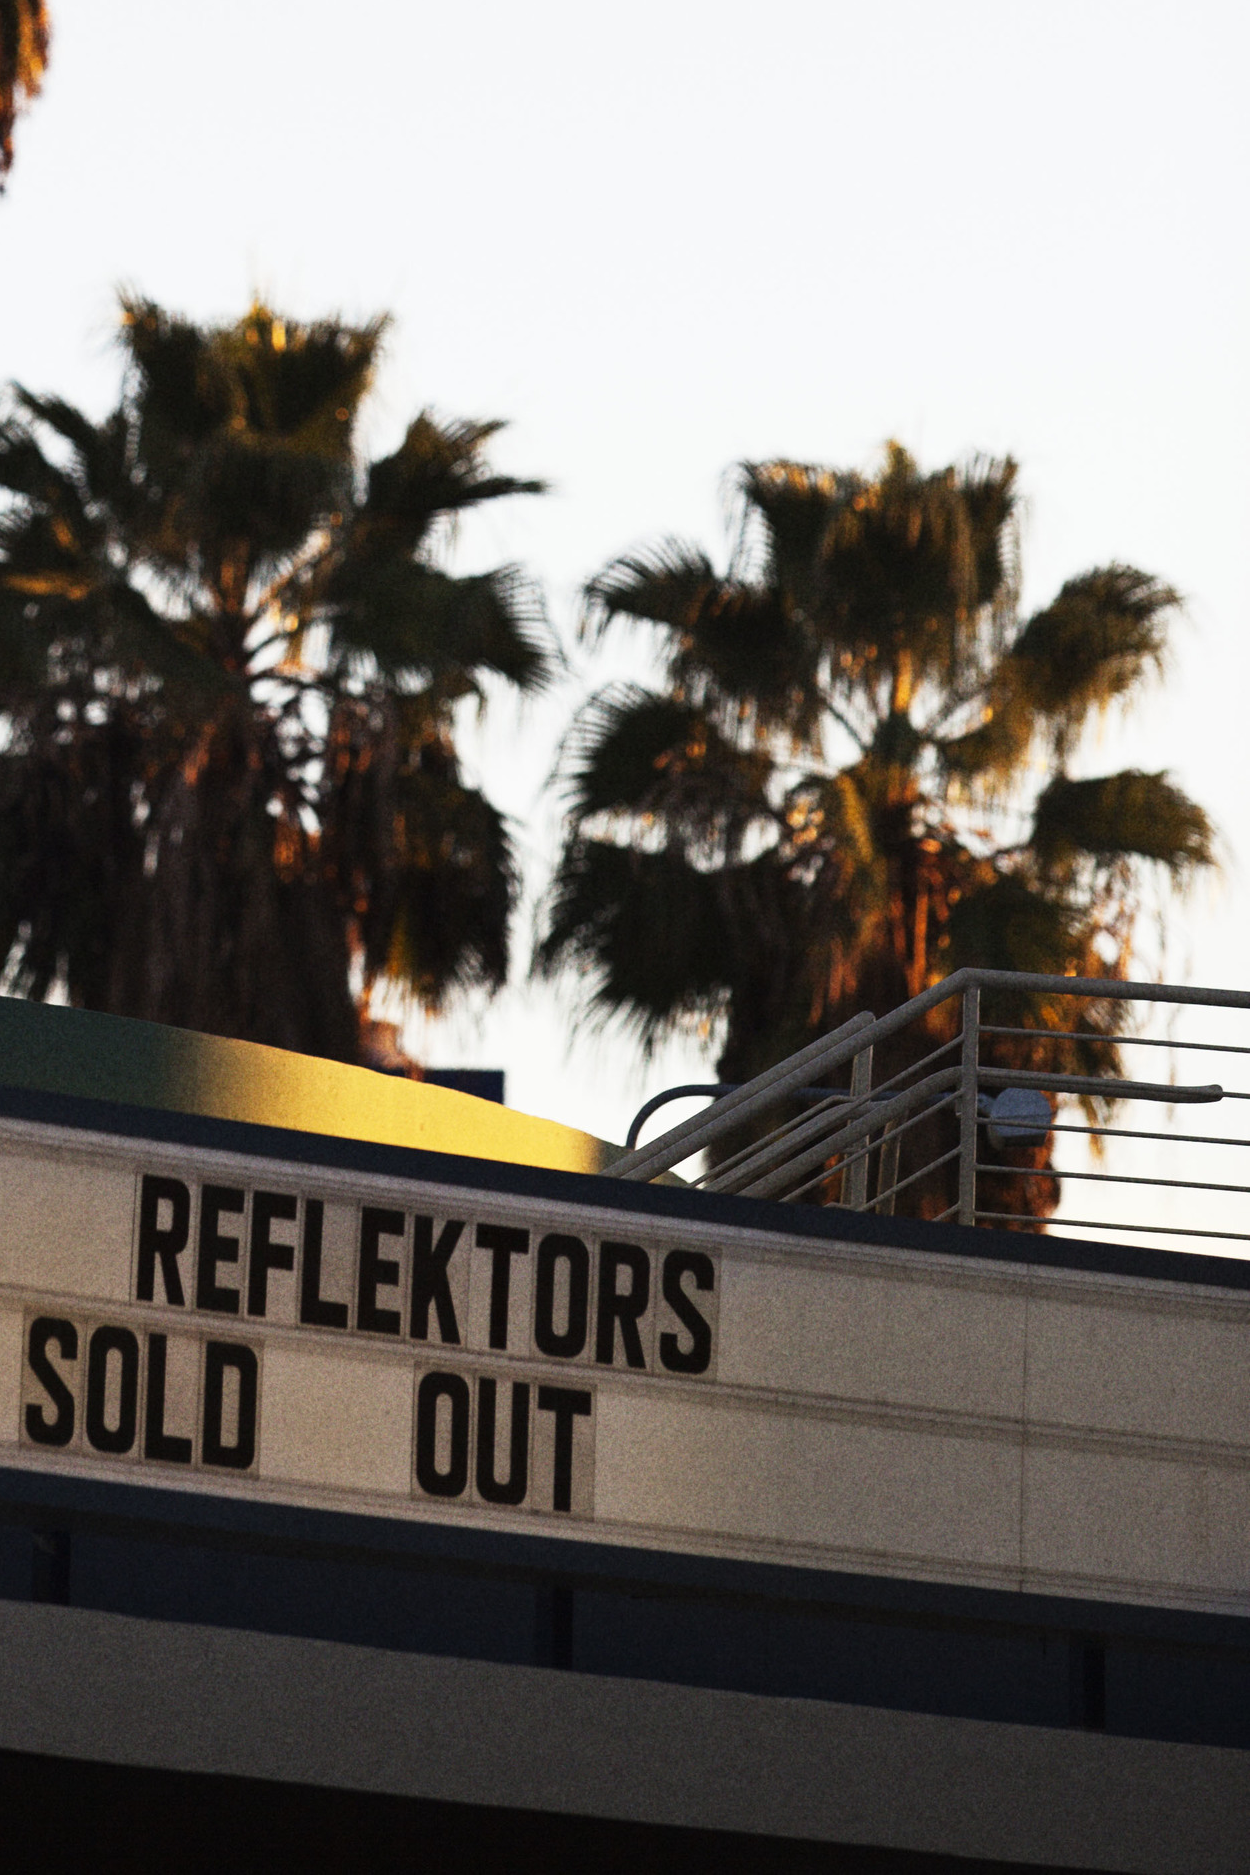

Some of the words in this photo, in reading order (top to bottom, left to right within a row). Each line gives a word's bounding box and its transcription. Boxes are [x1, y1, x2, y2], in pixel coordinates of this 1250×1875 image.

[136, 1173, 716, 1375] REFLEKTORS
[25, 1316, 258, 1470] SOLD
[416, 1371, 592, 1513] OUT
